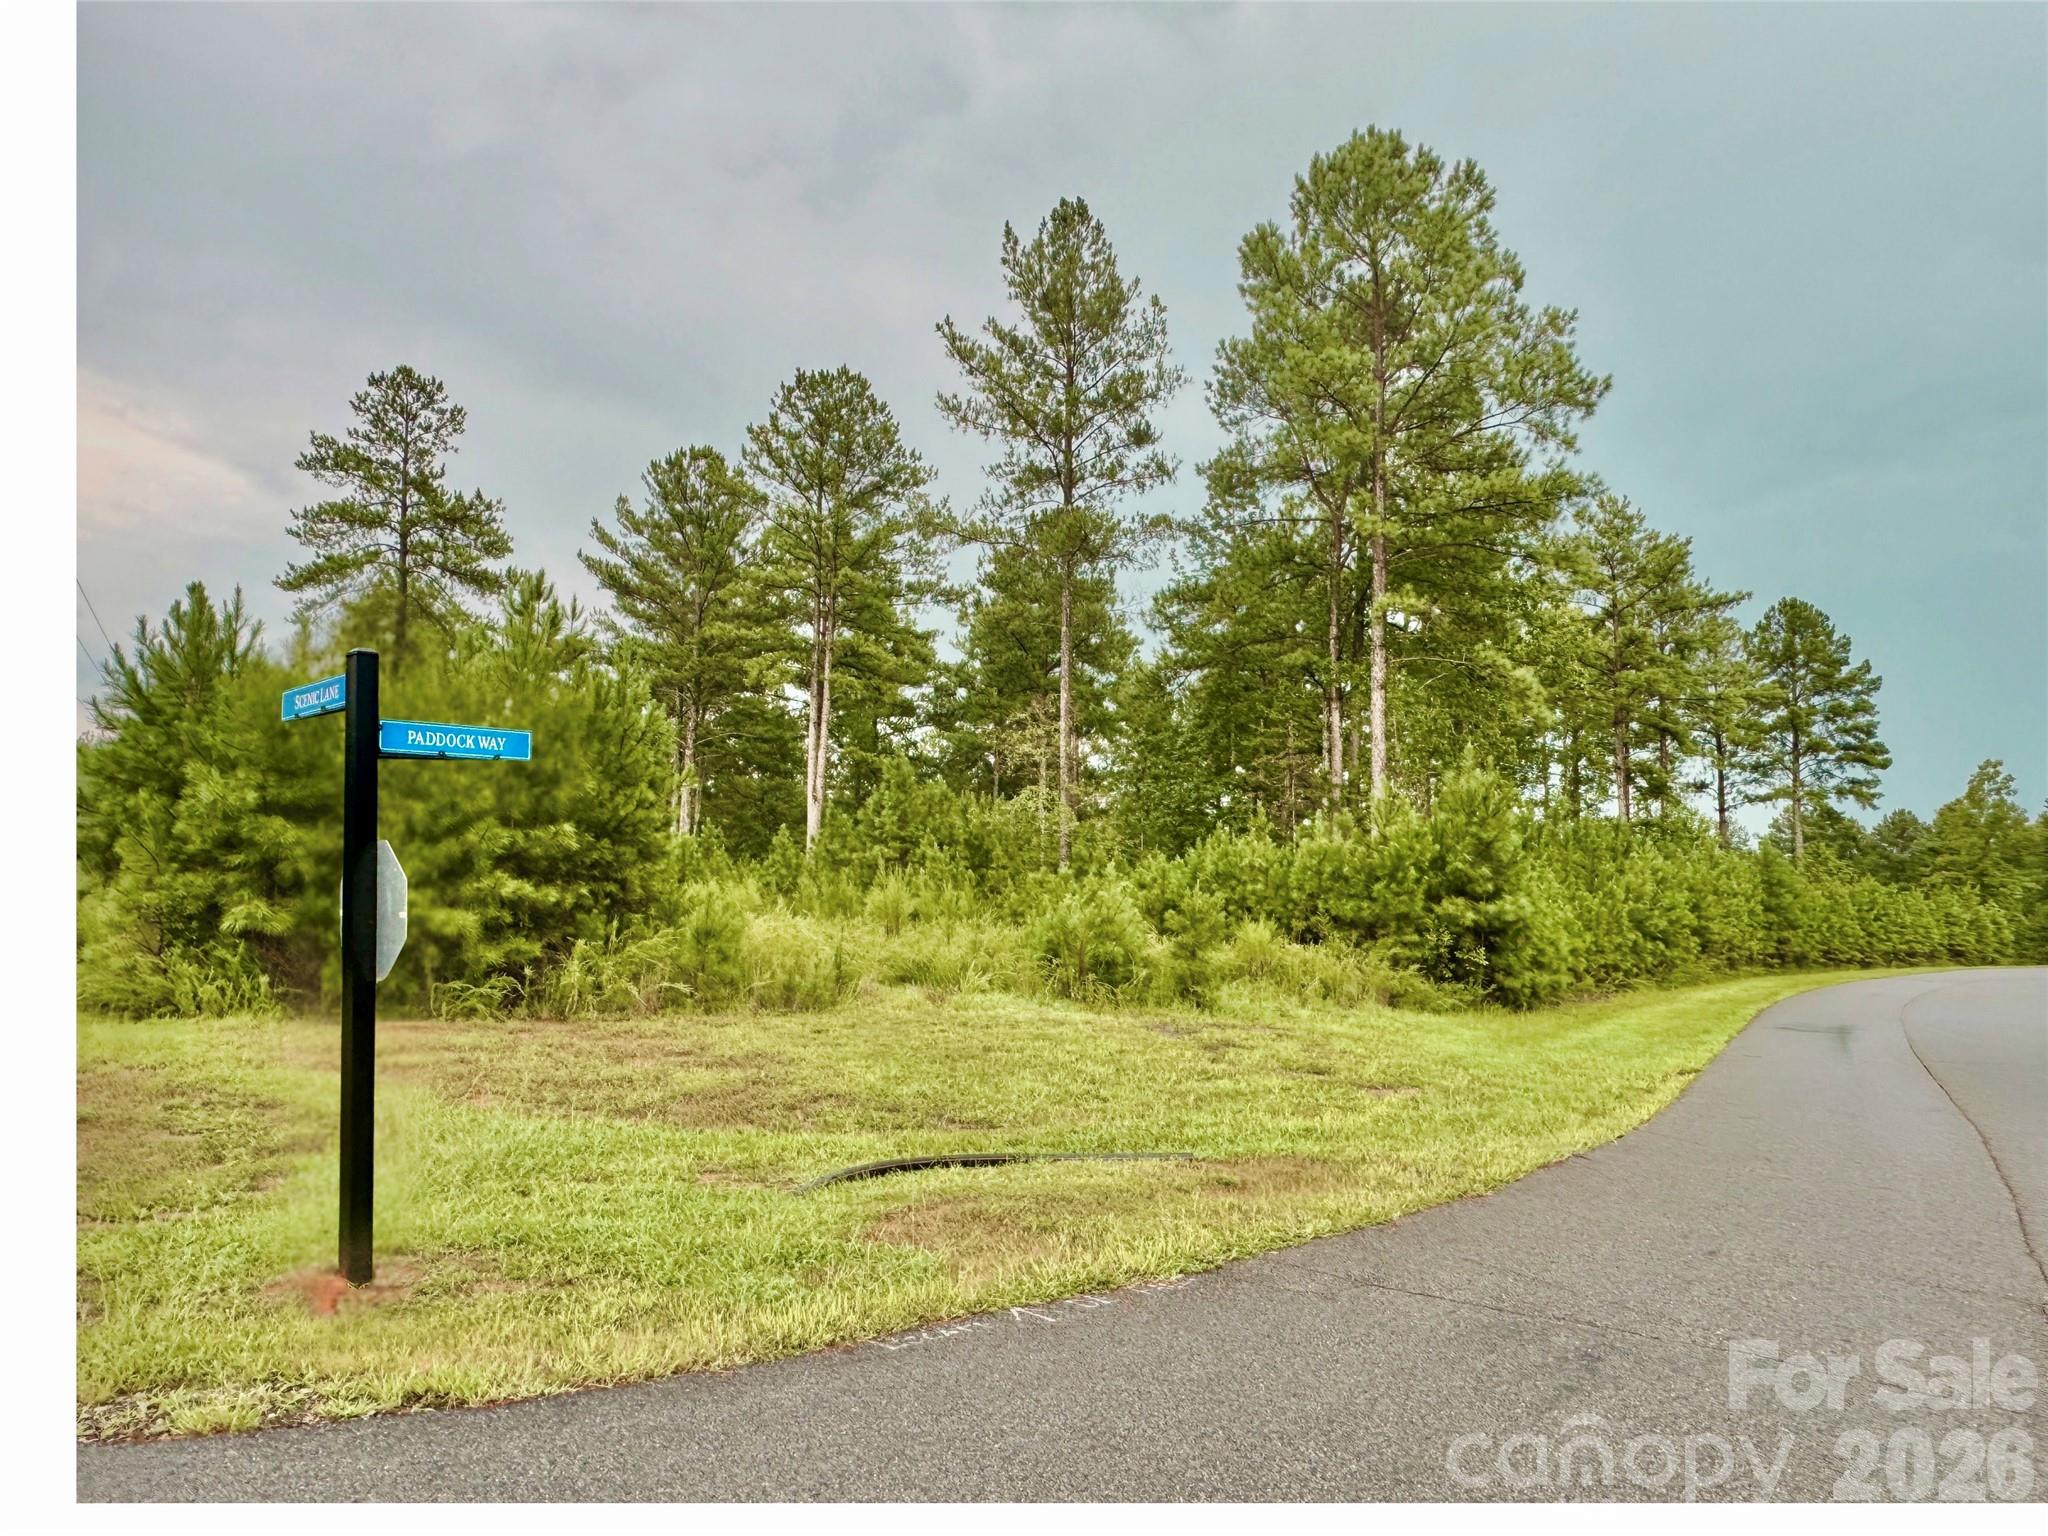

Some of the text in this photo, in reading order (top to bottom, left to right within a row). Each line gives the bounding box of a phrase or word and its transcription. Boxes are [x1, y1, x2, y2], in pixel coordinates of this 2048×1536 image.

[320, 684, 340, 703] LANE
[407, 730, 507, 751] PADDOCK WAY
